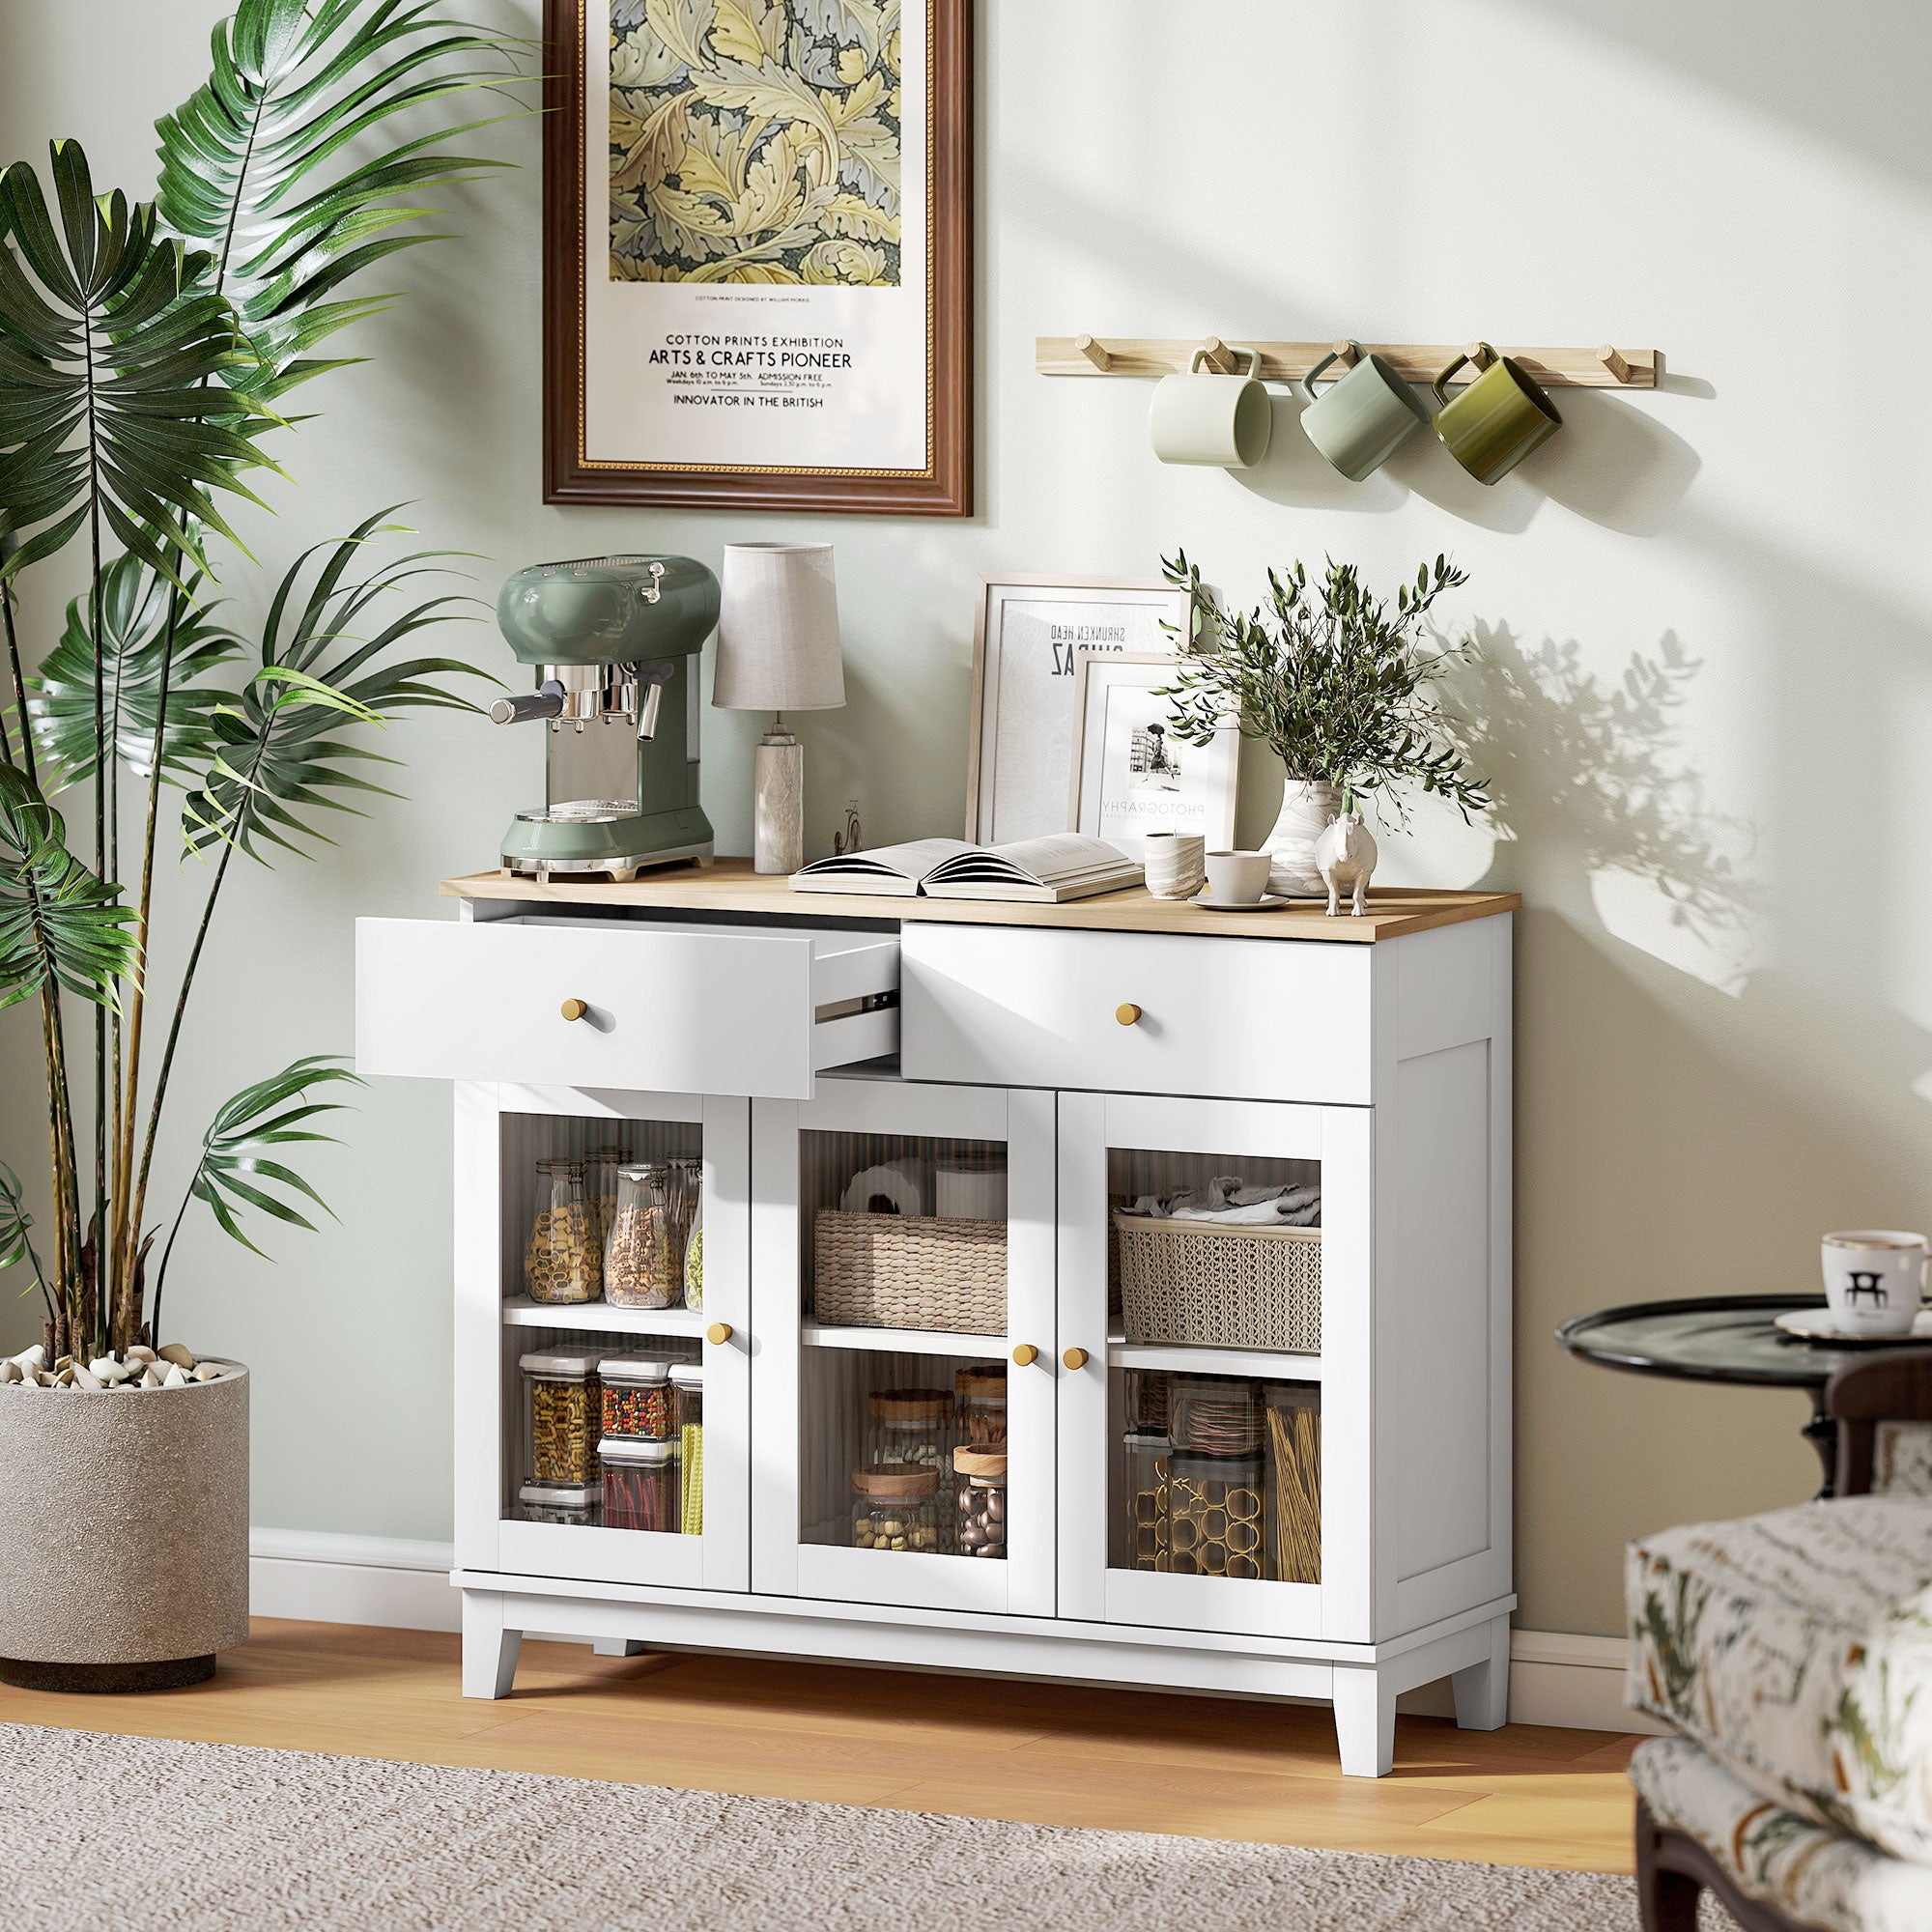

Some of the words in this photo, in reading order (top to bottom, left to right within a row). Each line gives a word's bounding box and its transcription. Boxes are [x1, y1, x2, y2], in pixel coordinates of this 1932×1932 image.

[666, 334, 720, 346] COTTON
[724, 335, 768, 347] PRINTS
[772, 336, 843, 348] EXHIBITION
[649, 349, 692, 364] ARTS
[696, 351, 705, 365] &
[711, 351, 776, 366] CRAFTS
[781, 352, 852, 368] PIONEER
[673, 395, 740, 406] INNOVATOR
[743, 397, 754, 406] IN
[758, 397, 780, 407] THE
[782, 397, 823, 408] BRITISH
